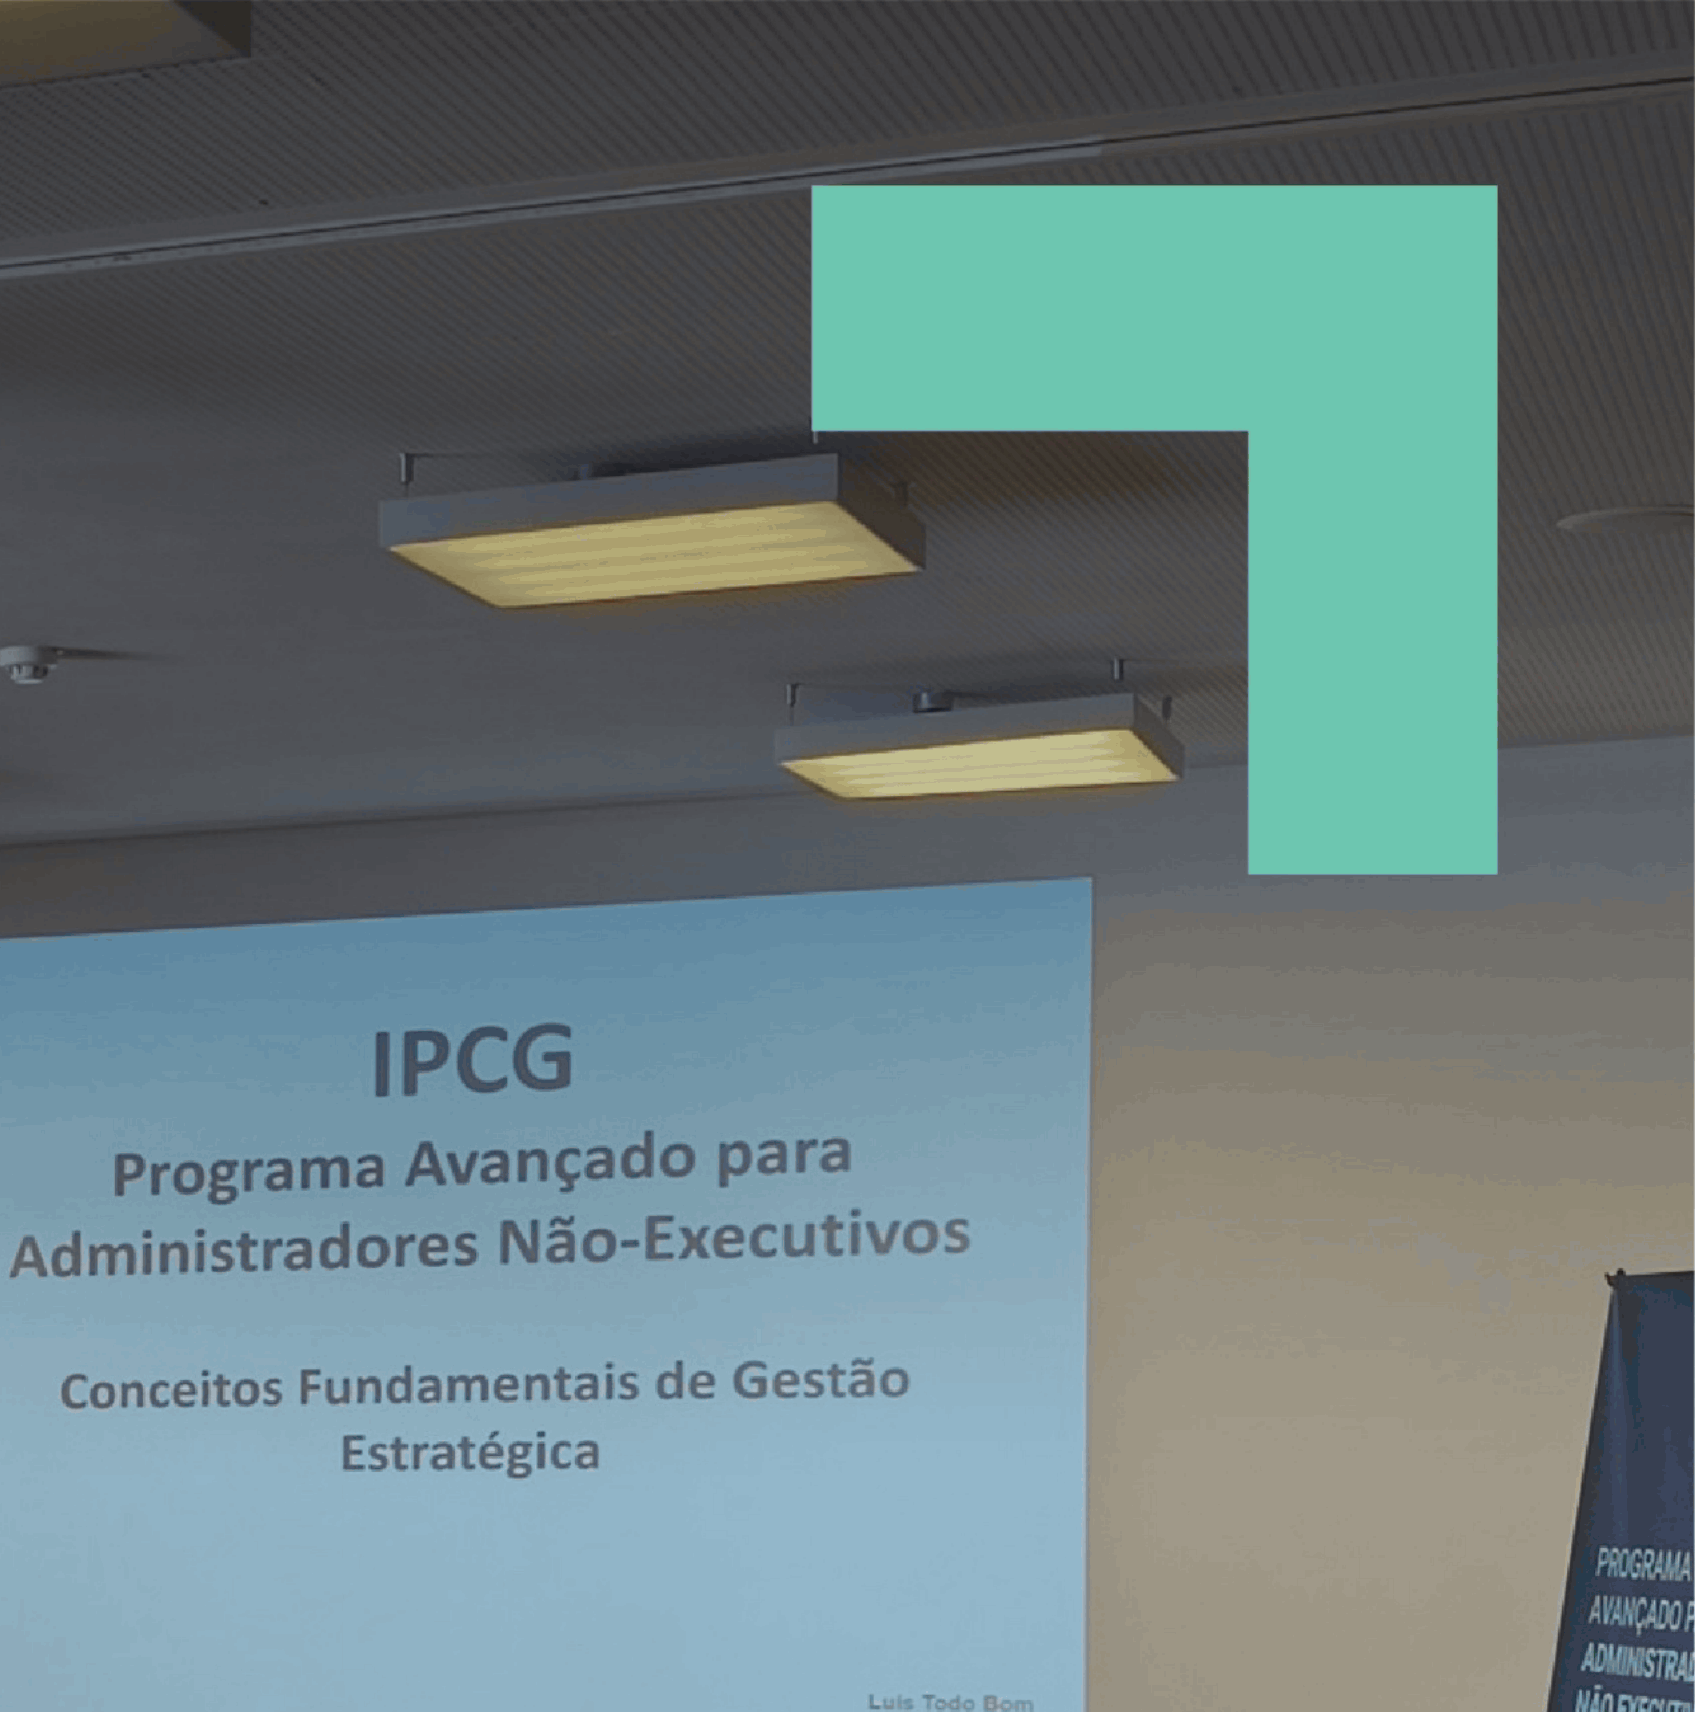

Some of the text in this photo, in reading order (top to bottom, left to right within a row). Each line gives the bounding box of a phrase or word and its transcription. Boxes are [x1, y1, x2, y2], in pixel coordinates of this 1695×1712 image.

[374, 1022, 572, 1098] IPCG
[114, 1130, 851, 1206] Programa Avançado para
[9, 1208, 972, 1279] Administradores Não-Executivos
[60, 1356, 911, 1411] Conceitos Fundamentais de Gestão
[341, 1430, 601, 1479] Estratégica
[1594, 1545, 1692, 1582] PROGRAMA
[1587, 1595, 1683, 1637] AVANÇADO
[922, 1693, 976, 1712] Todo
[983, 1694, 1035, 1712] Bom
